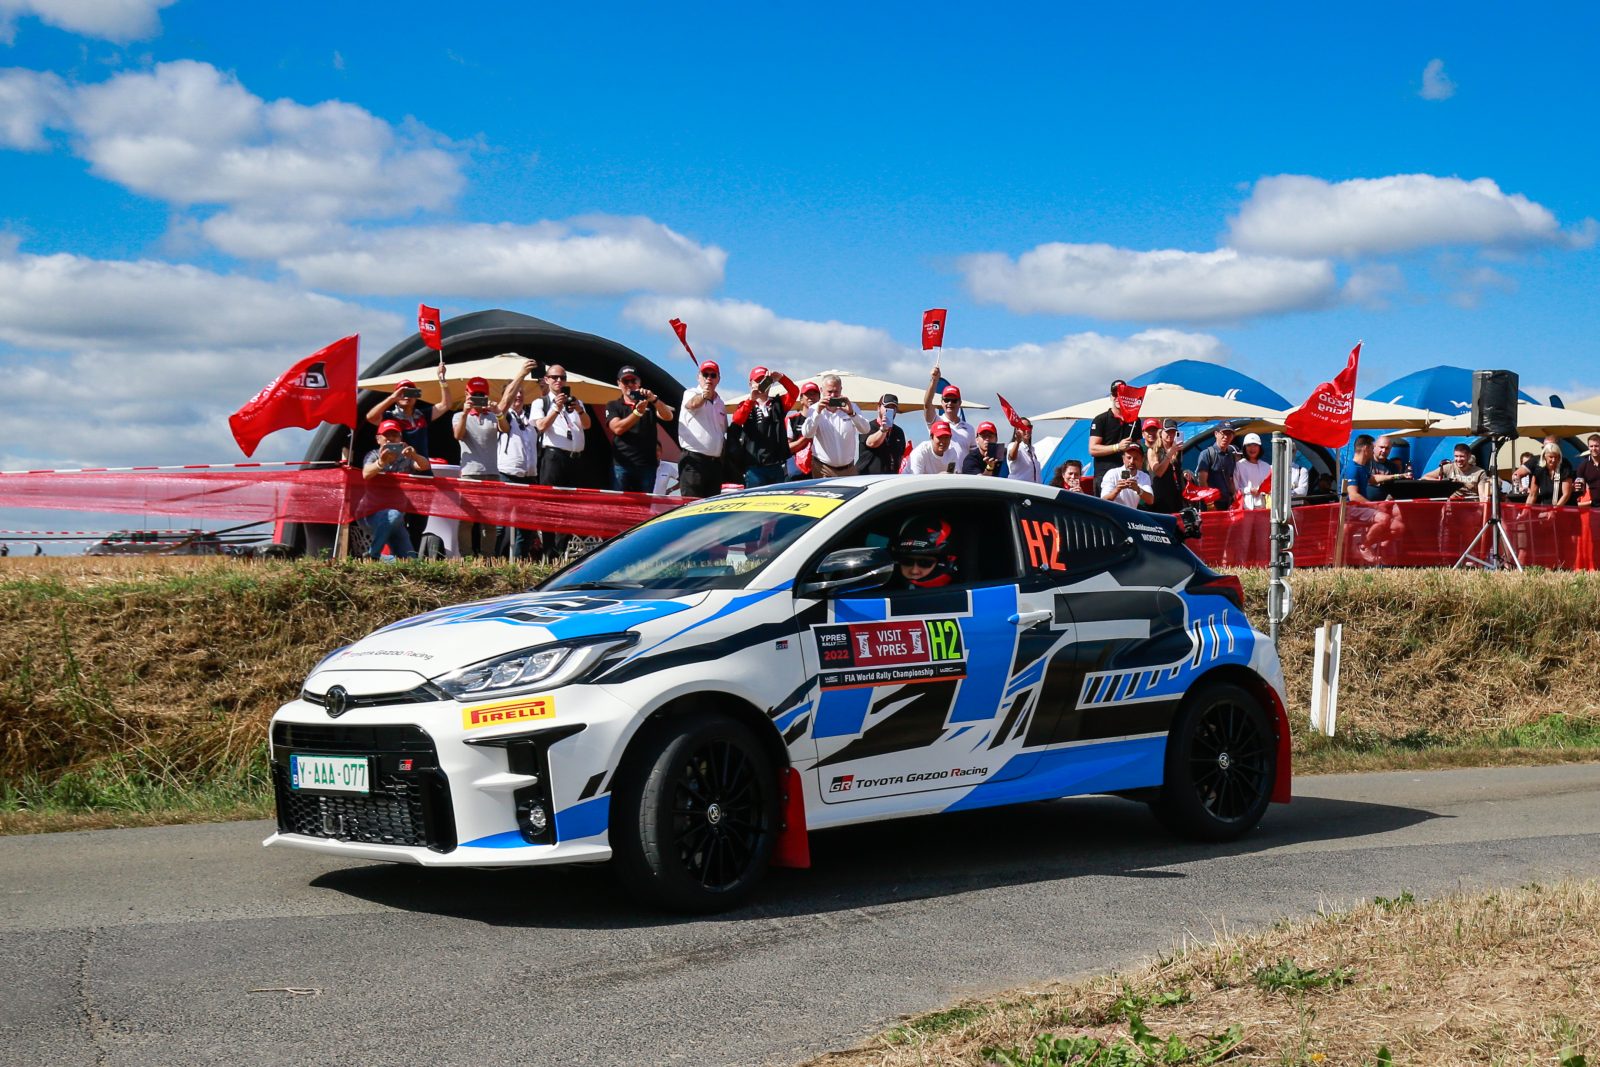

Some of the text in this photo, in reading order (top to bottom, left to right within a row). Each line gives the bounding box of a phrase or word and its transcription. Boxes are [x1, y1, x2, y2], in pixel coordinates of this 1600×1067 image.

[783, 502, 810, 512] H2
[1021, 519, 1067, 571] H2
[820, 633, 847, 642] YPRES
[876, 629, 902, 642] VISIT
[927, 620, 961, 660] H2
[403, 650, 434, 661] Racing
[824, 649, 850, 661] 2022
[875, 643, 908, 657] YPRES
[844, 667, 934, 683] FIA World Rally Championship
[471, 701, 546, 725] PIRELLI
[856, 766, 989, 789] TOYOTA GAZOO Racing
[829, 781, 851, 793] GR
